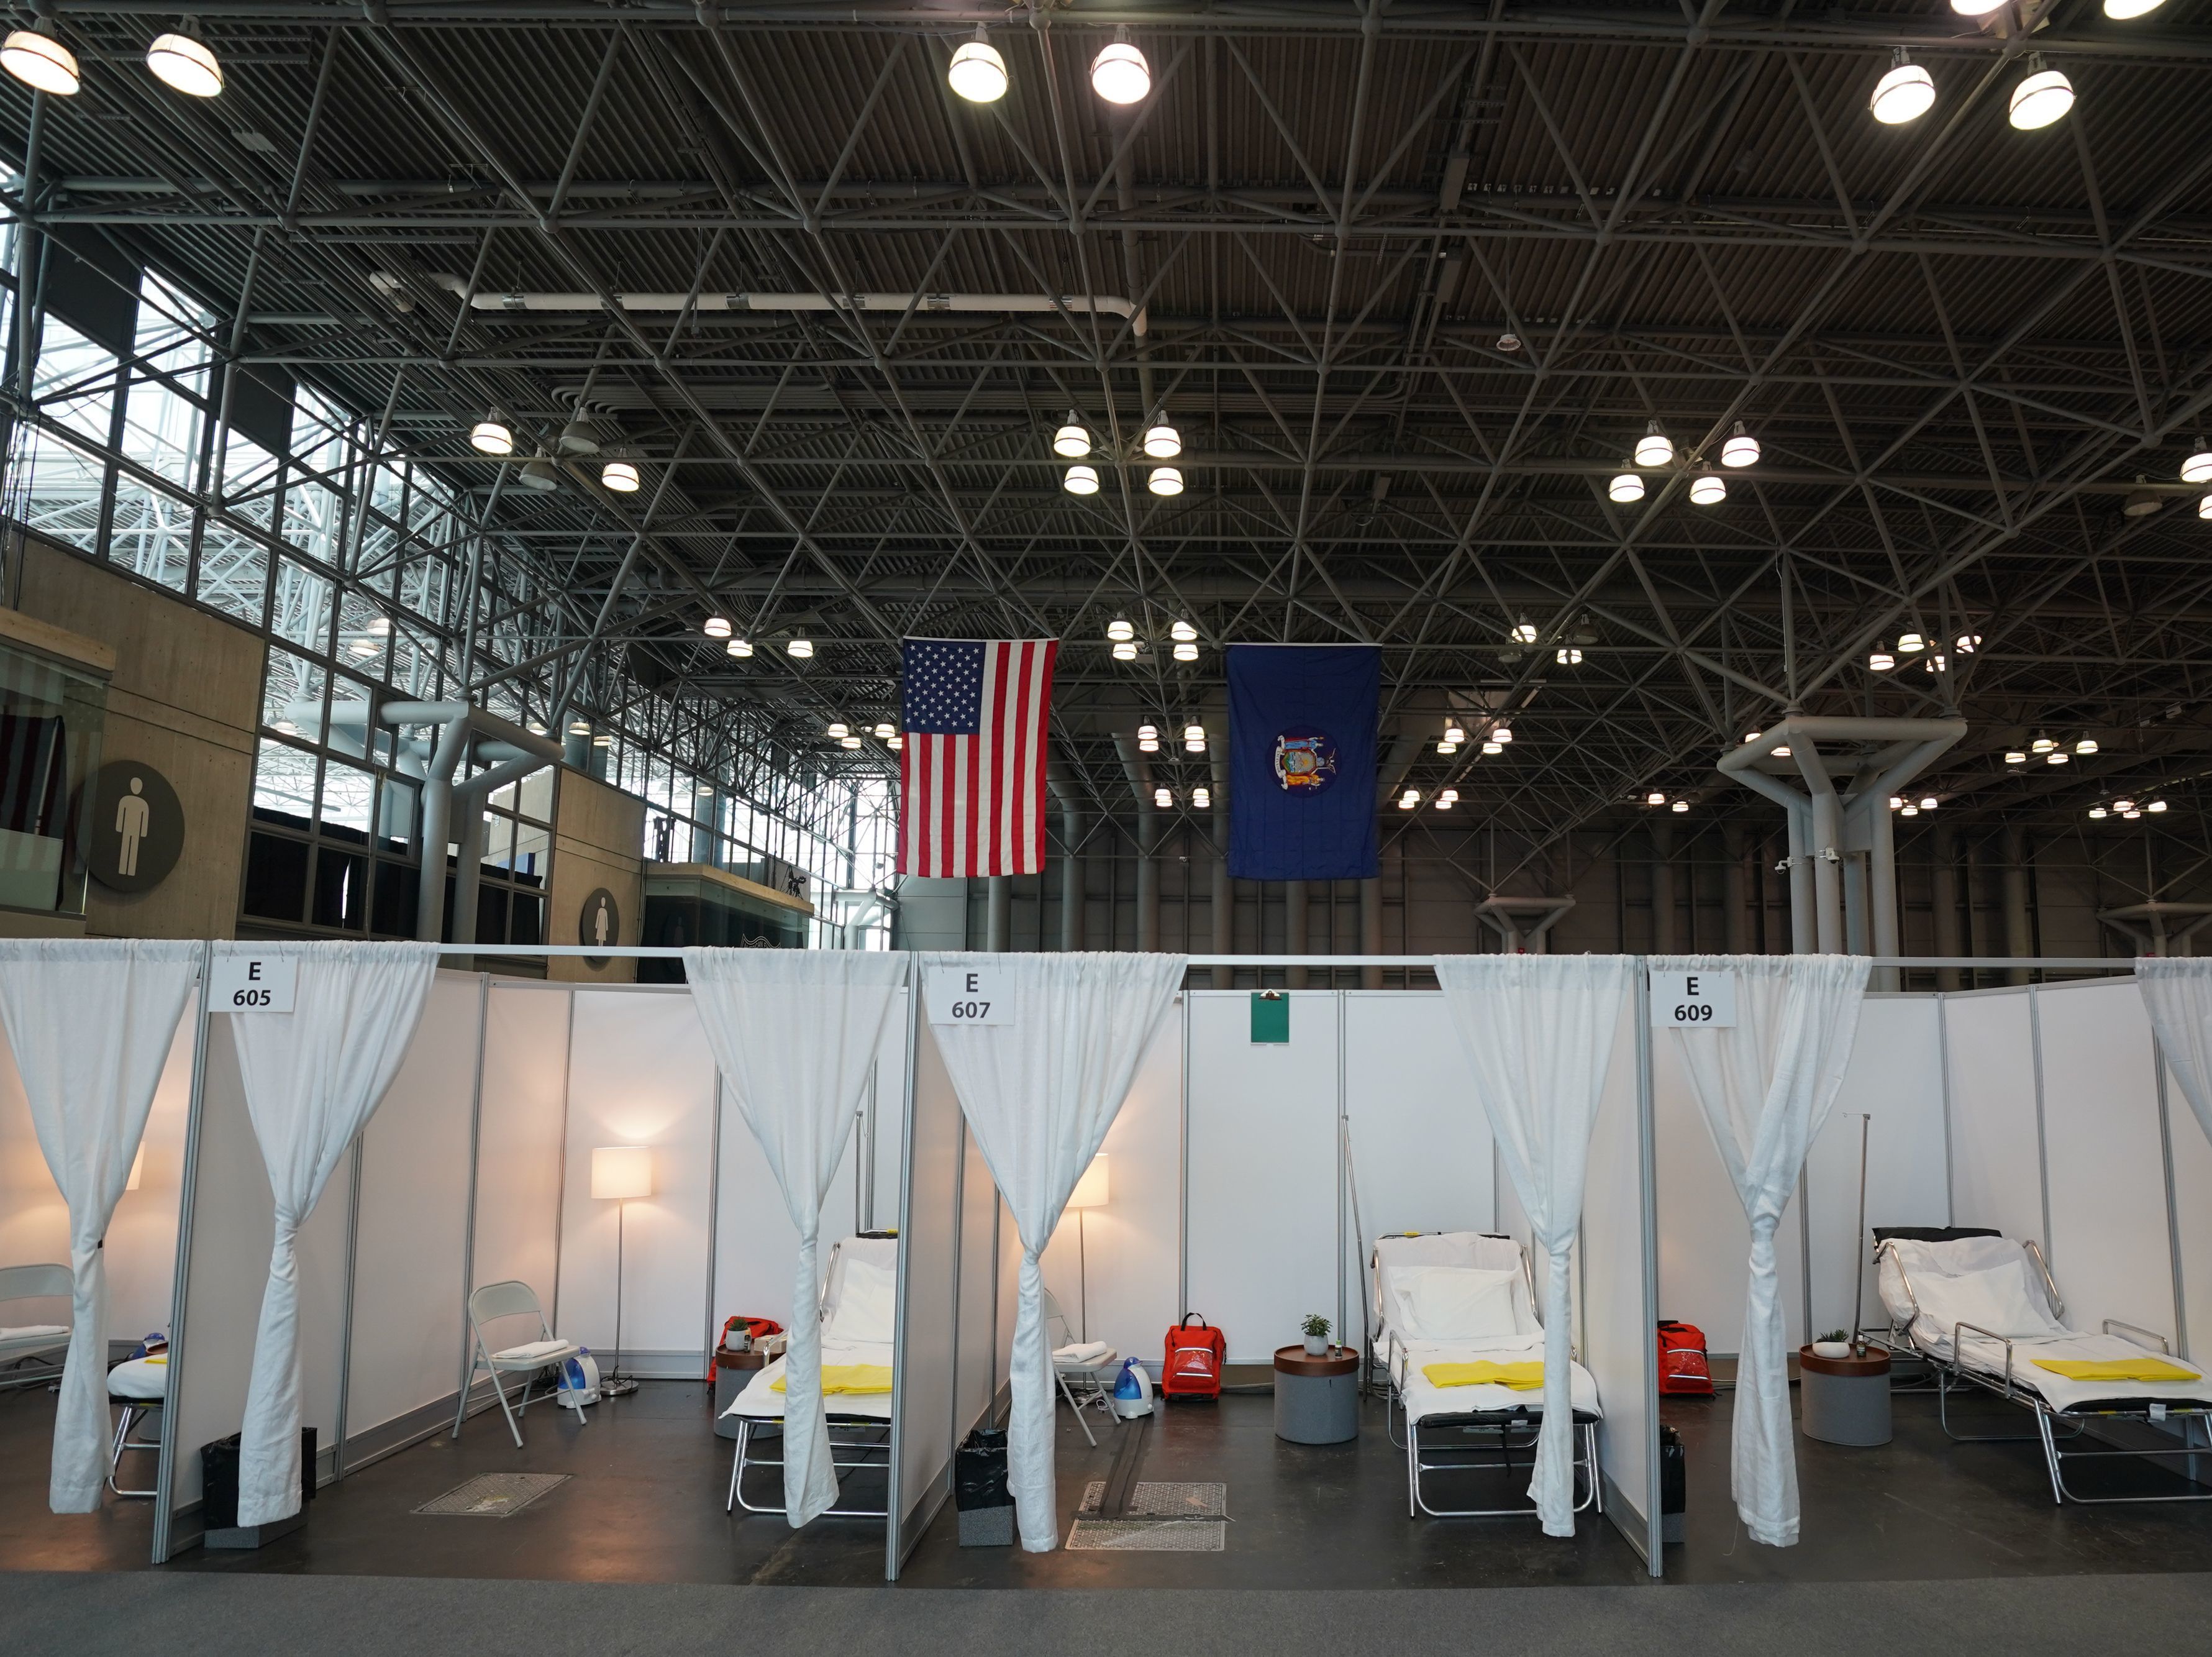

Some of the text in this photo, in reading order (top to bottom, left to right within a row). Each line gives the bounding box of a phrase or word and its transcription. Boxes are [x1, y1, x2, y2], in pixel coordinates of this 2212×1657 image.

[248, 962, 261, 980] E
[967, 974, 978, 992] E
[1687, 977, 1699, 995] E
[234, 990, 270, 1006] 605
[952, 1002, 990, 1018] 607
[1675, 1005, 1712, 1021] 609
